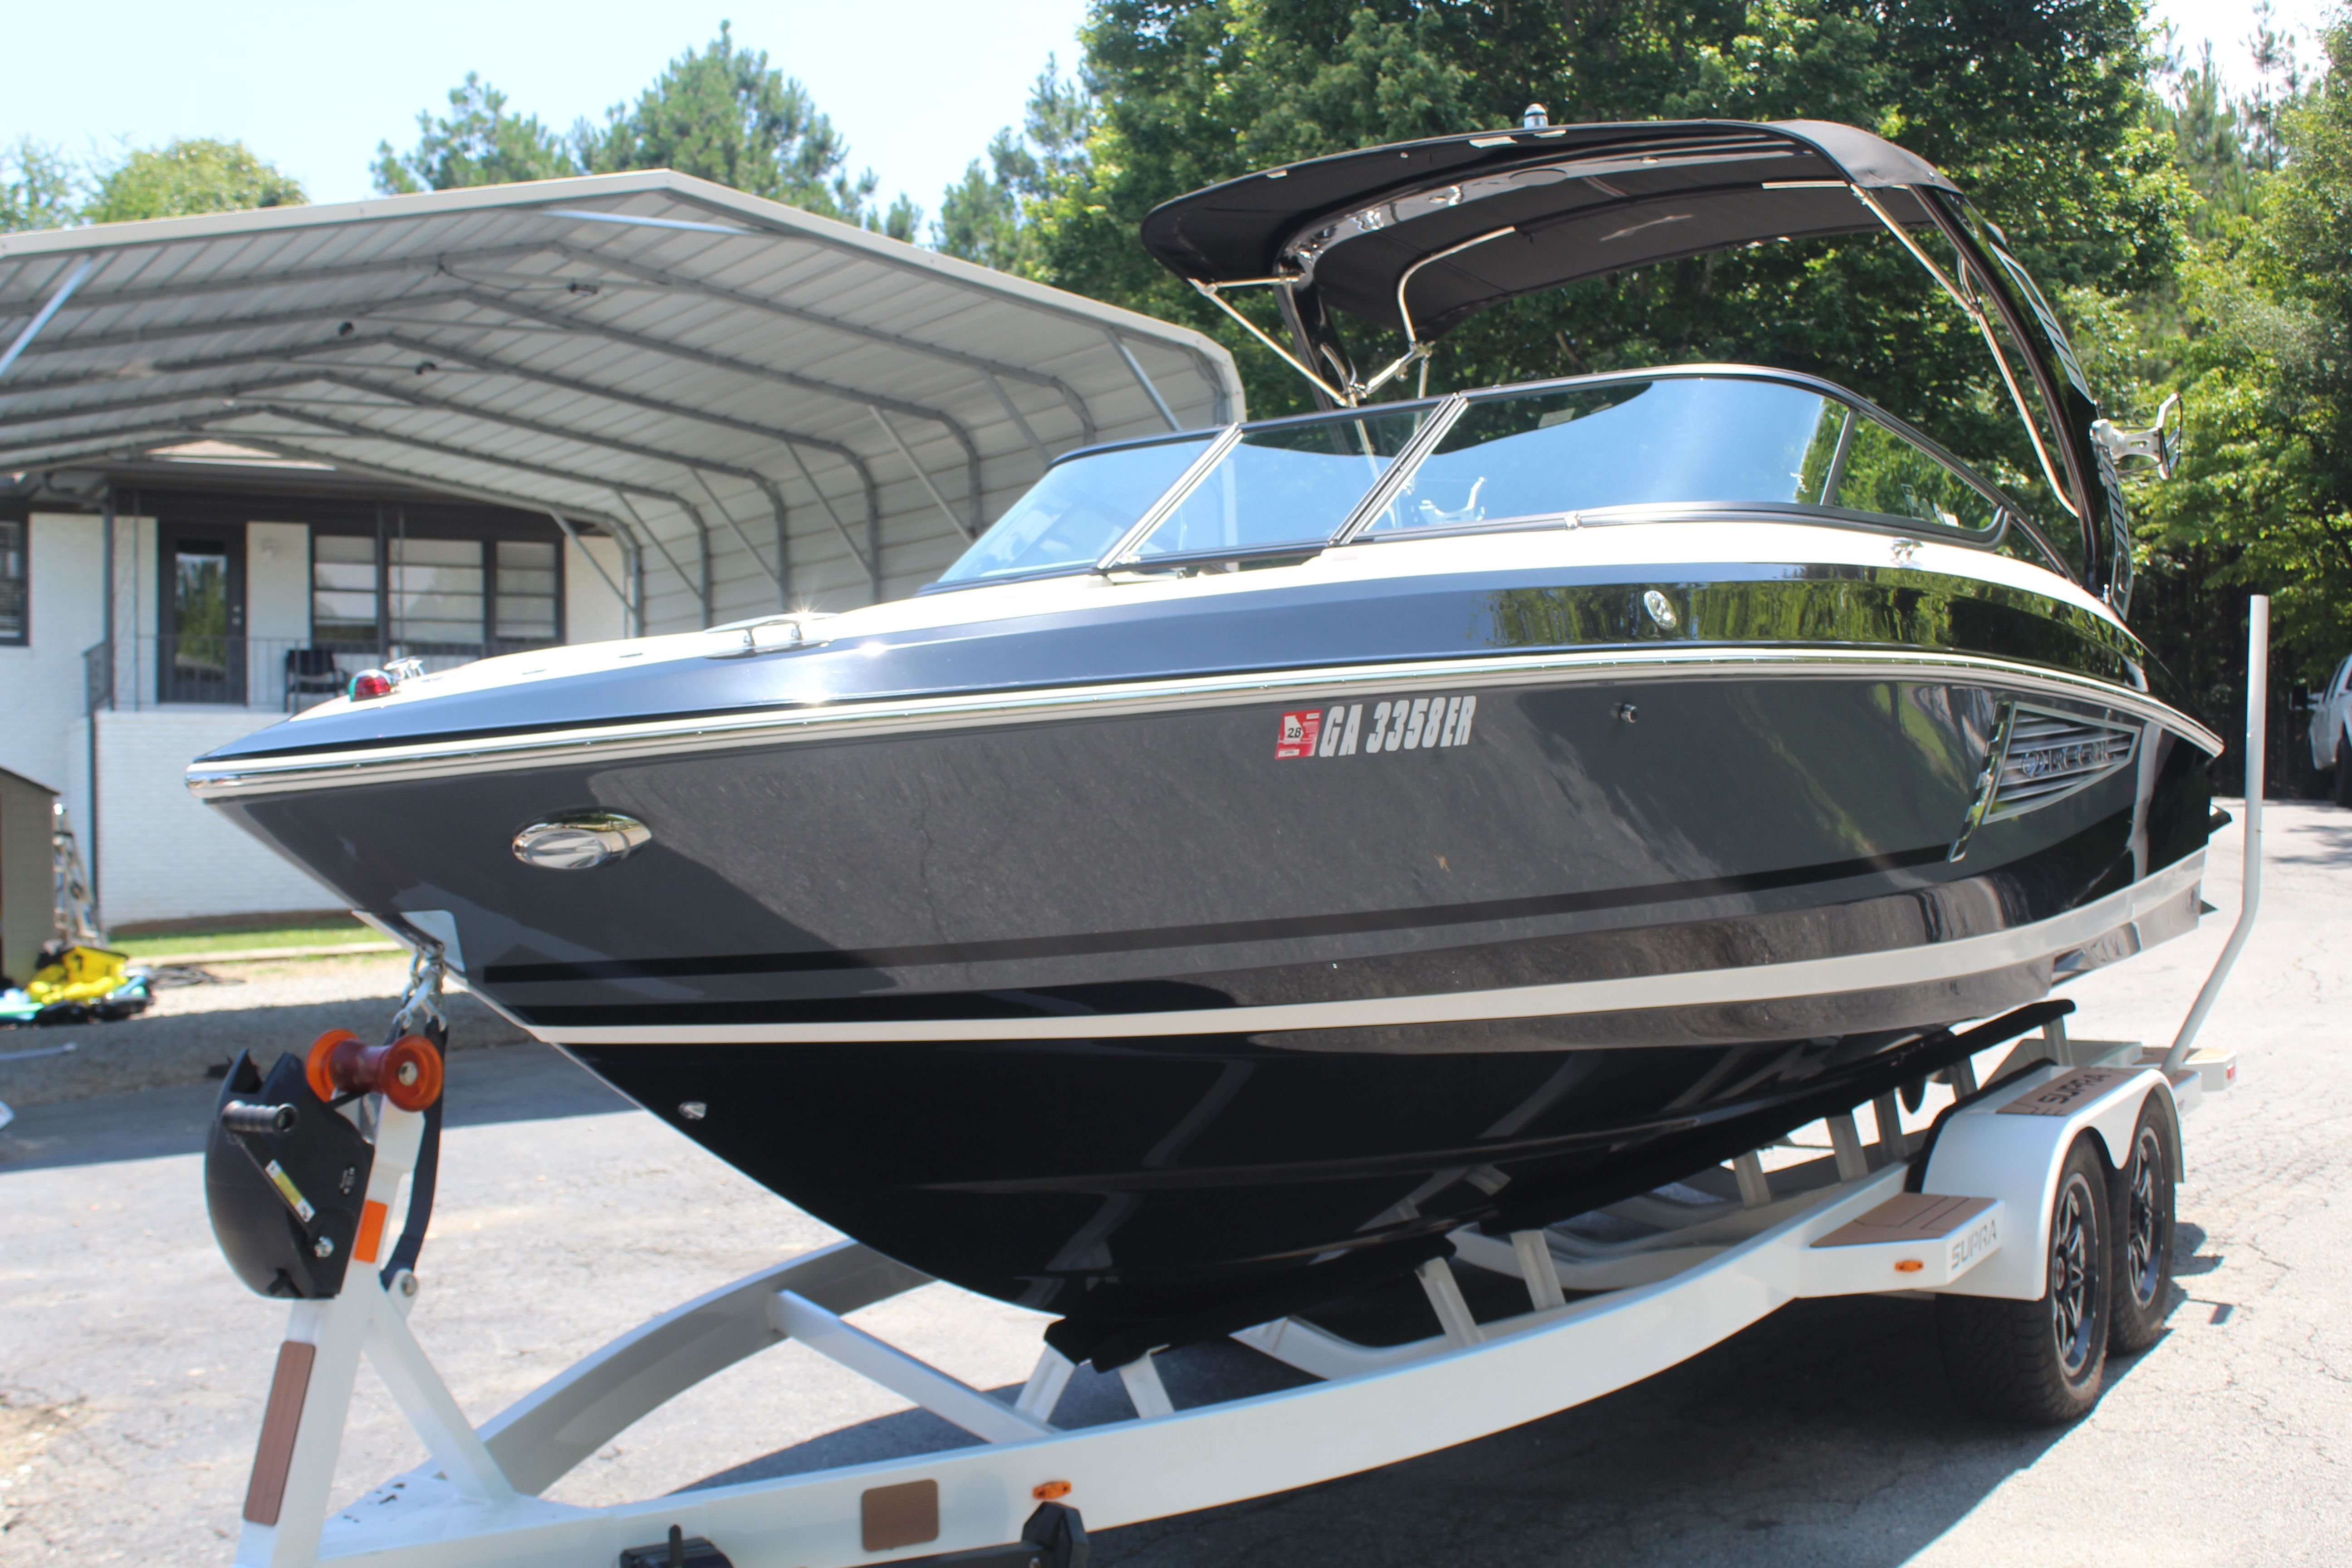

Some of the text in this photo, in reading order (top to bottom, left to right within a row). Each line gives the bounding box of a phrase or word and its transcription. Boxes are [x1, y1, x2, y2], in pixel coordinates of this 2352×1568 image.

[1288, 727, 1301, 738] 28
[1319, 696, 1476, 757] GA 3358ER
[2037, 1074, 2112, 1104] SUPRA
[1950, 1219, 1997, 1270] SUPRA
